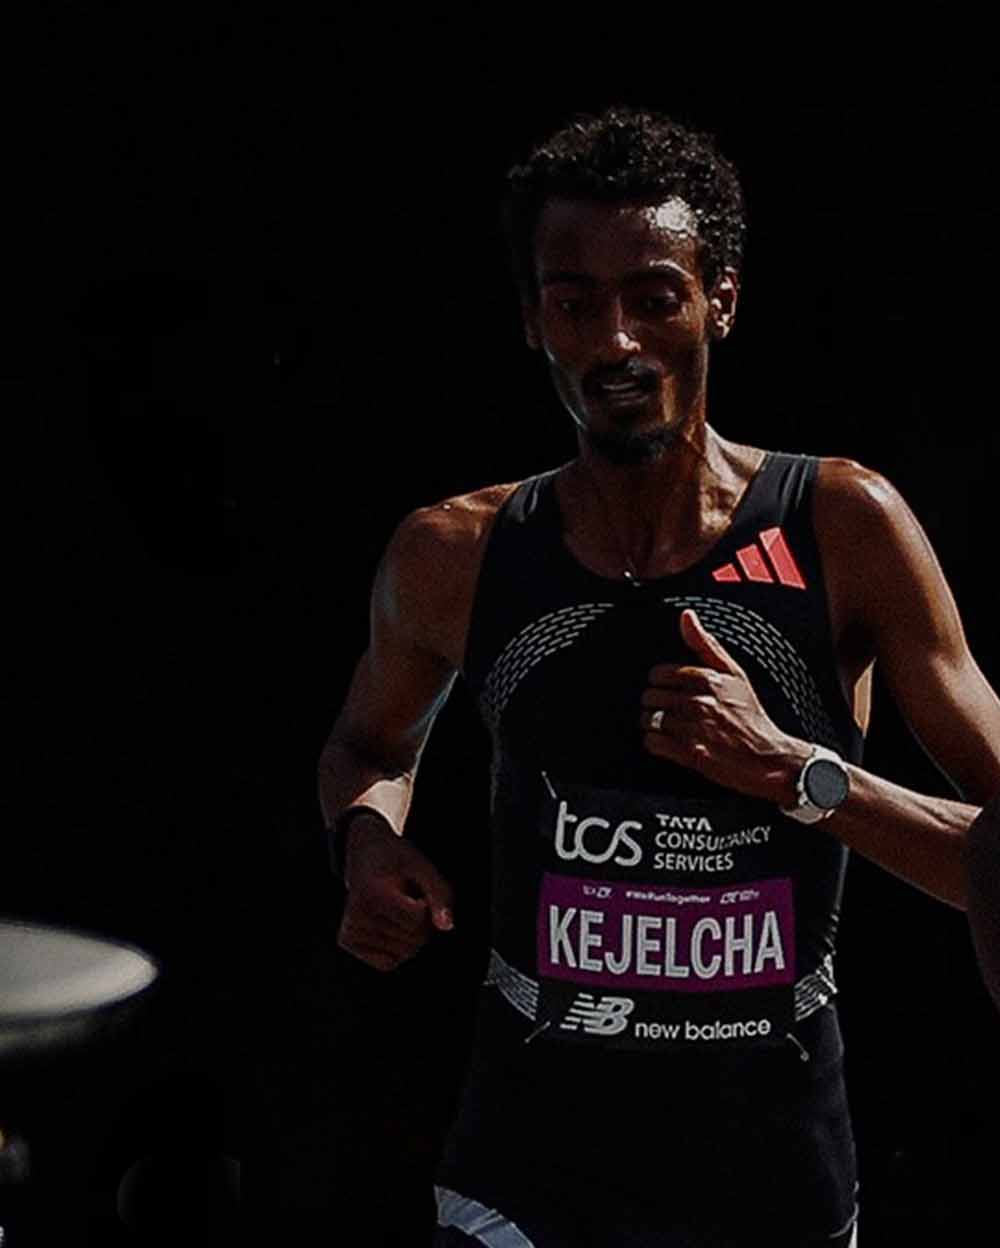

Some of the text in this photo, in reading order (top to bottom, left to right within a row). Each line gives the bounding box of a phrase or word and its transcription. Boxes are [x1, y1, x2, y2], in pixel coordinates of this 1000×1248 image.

[655, 813, 712, 831] TATA
[554, 800, 643, 867] tcs
[653, 852, 734, 872] SERVICES
[548, 904, 785, 979] KEJELCHA
[634, 1019, 771, 1040] new balance
